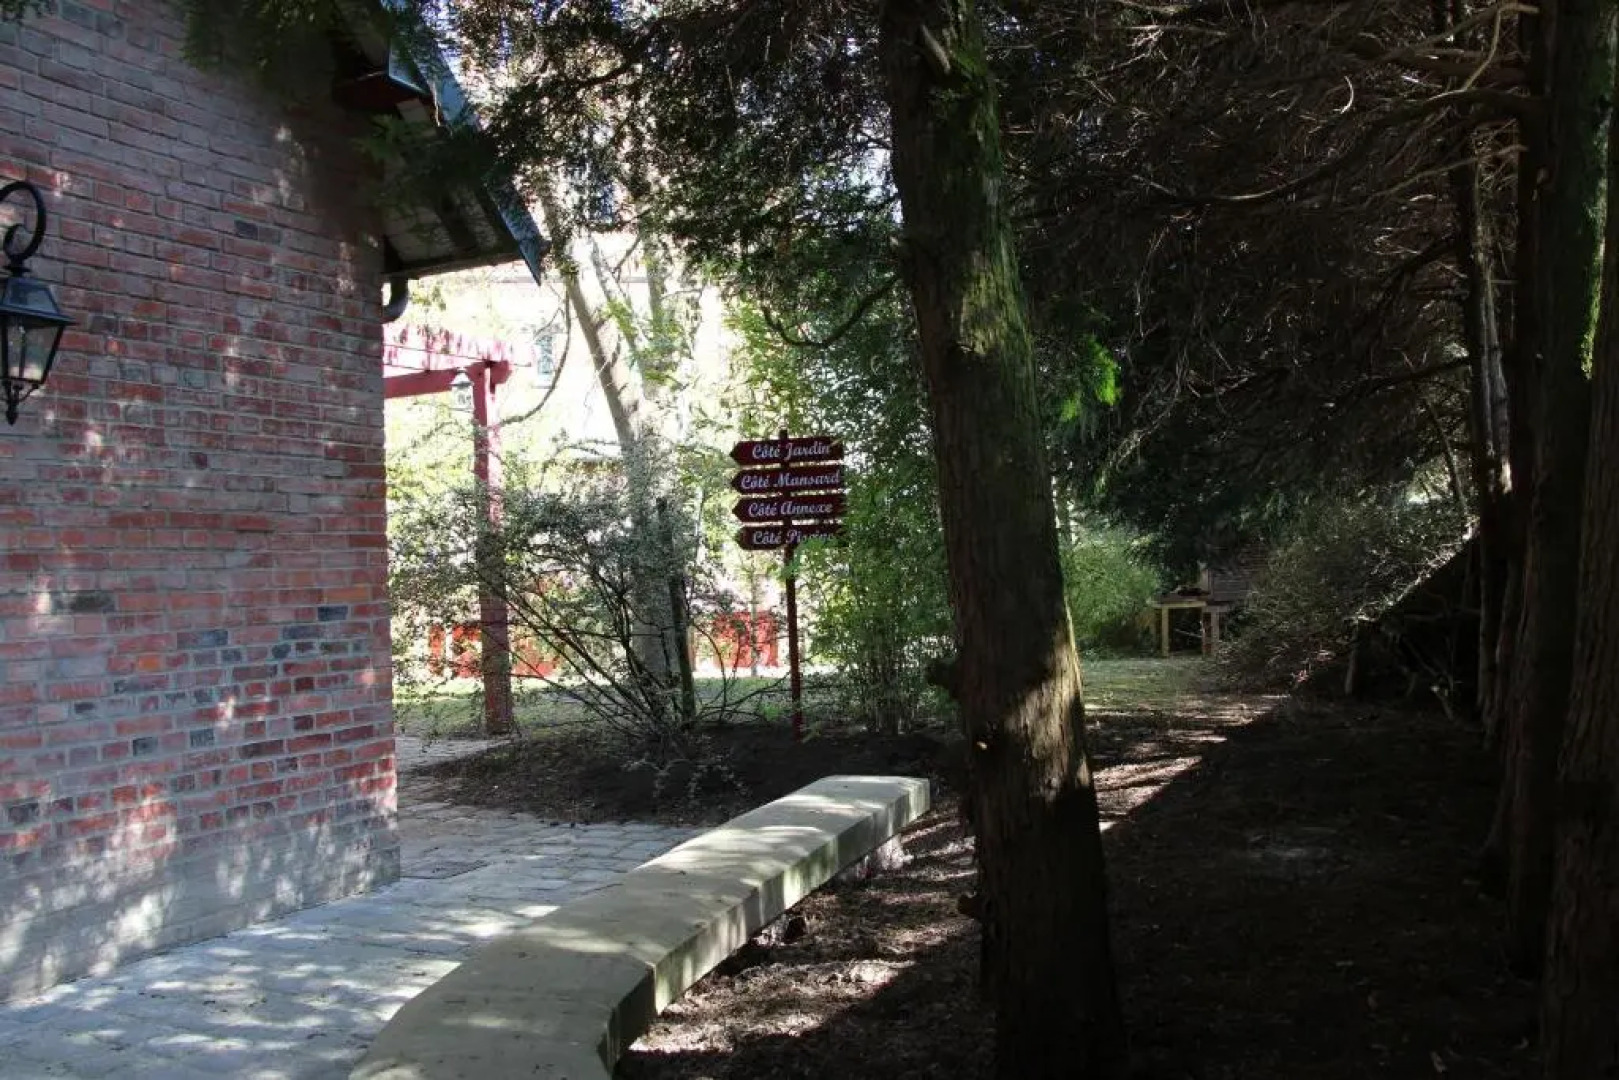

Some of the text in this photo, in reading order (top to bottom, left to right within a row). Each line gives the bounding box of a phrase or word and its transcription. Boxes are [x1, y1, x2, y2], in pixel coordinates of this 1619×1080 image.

[752, 441, 830, 461] Côté Jardin
[741, 469, 840, 489] Côté Mansard
[748, 501, 833, 517] Côté Annexe
[753, 530, 781, 544] Côté
